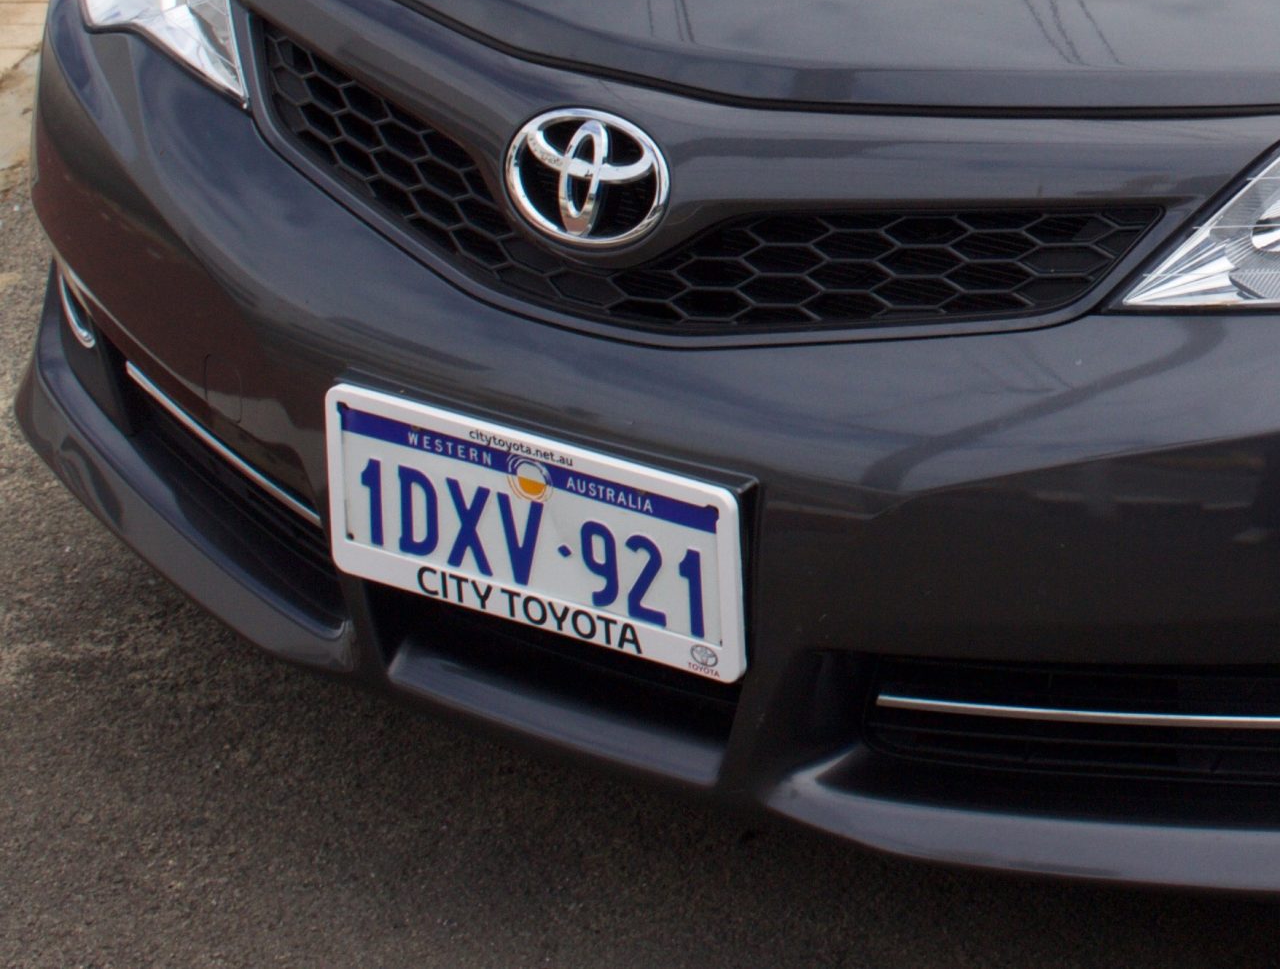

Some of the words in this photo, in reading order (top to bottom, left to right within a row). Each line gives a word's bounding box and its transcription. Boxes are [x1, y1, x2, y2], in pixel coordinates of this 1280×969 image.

[407, 431, 493, 466] WESTERN
[565, 475, 654, 514] AUSTRALIA
[469, 428, 574, 467] citytoyota.net.au
[416, 566, 494, 611] CITY
[500, 587, 643, 655] TOYOTA
[687, 661, 721, 679] TOYOTA
